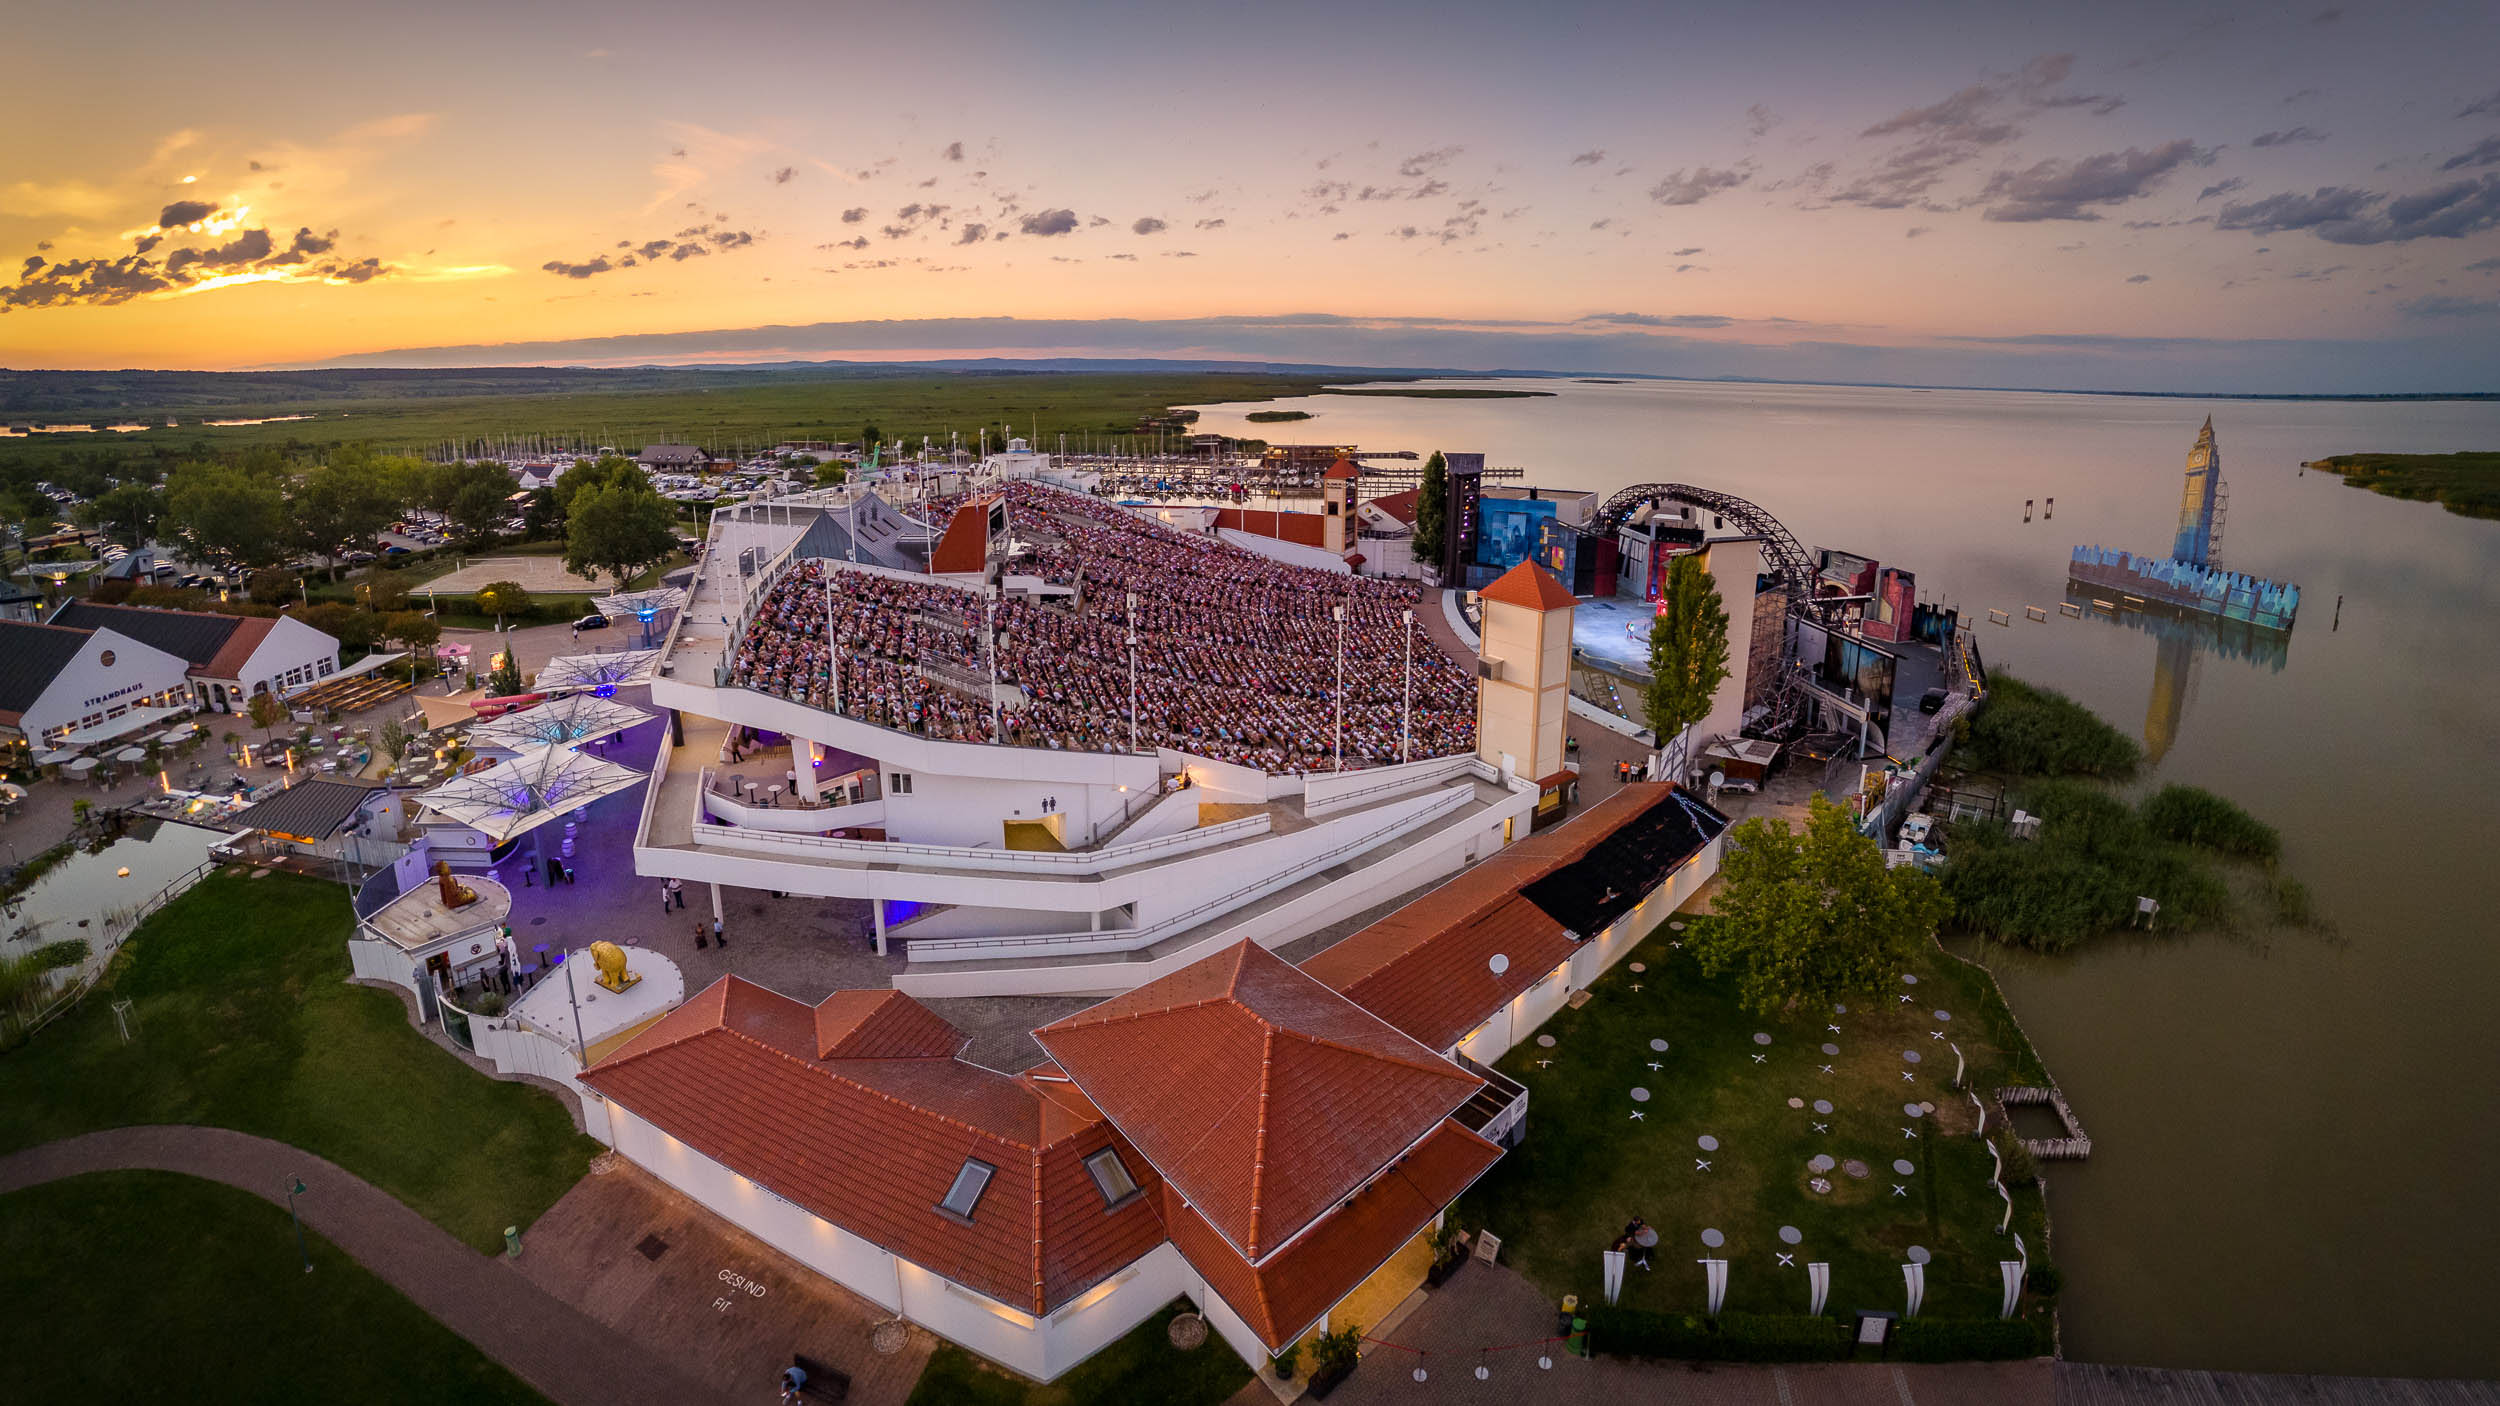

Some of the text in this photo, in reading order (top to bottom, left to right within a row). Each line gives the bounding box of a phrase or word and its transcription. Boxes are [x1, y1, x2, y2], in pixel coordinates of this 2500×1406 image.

[84, 682, 143, 708] STRANDHAUS
[718, 1269, 766, 1297] GESUND
[711, 1297, 732, 1313] FIT
